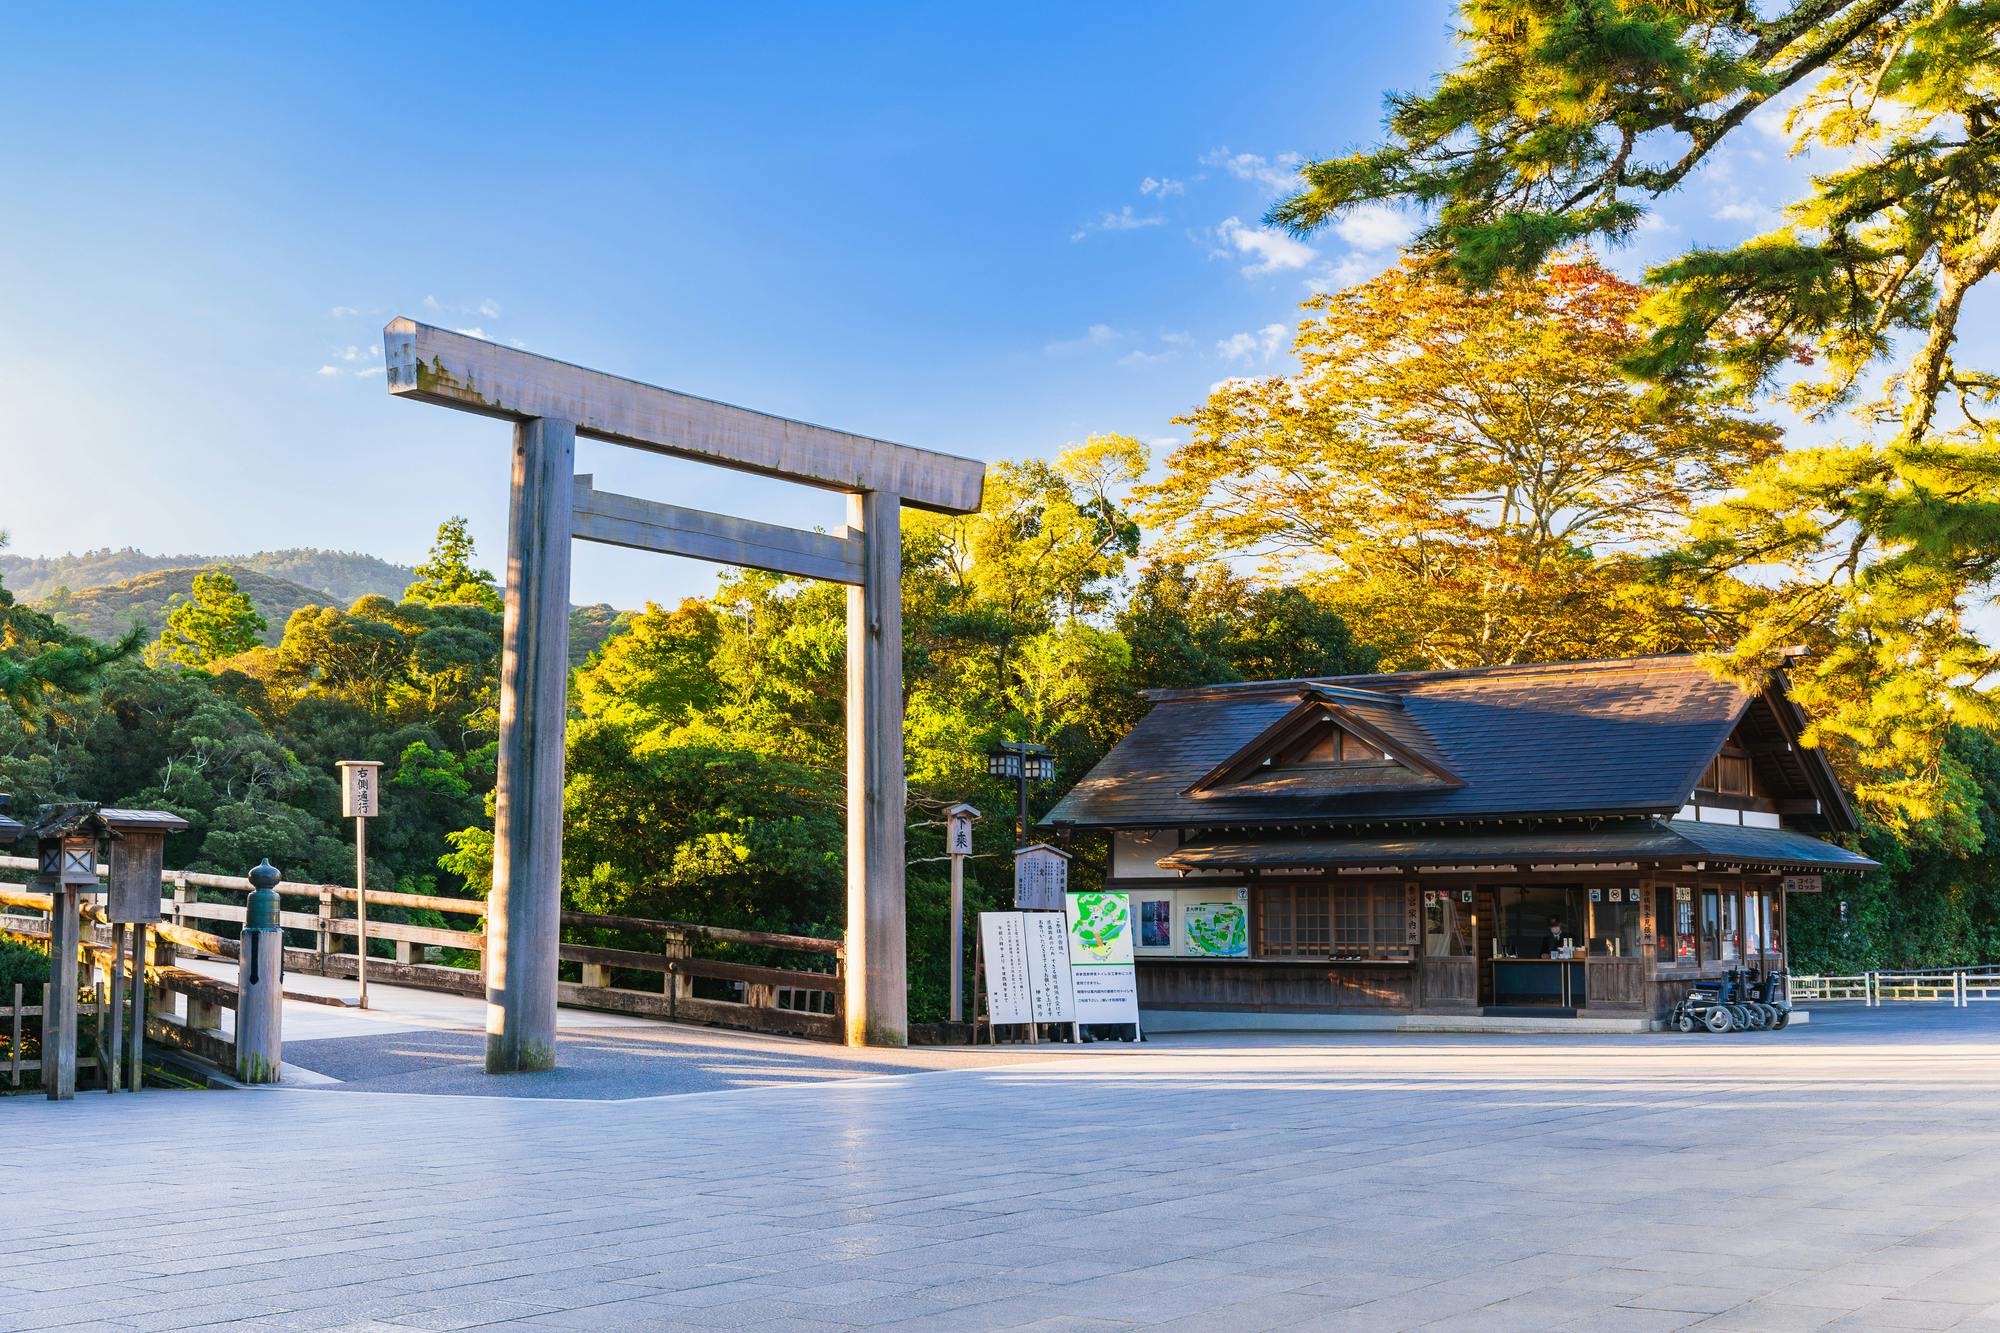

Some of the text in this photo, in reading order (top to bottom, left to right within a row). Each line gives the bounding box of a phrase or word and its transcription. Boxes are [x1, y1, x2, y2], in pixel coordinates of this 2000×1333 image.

[357, 767, 369, 814] 右側通行
[956, 816, 967, 848] 下乗
